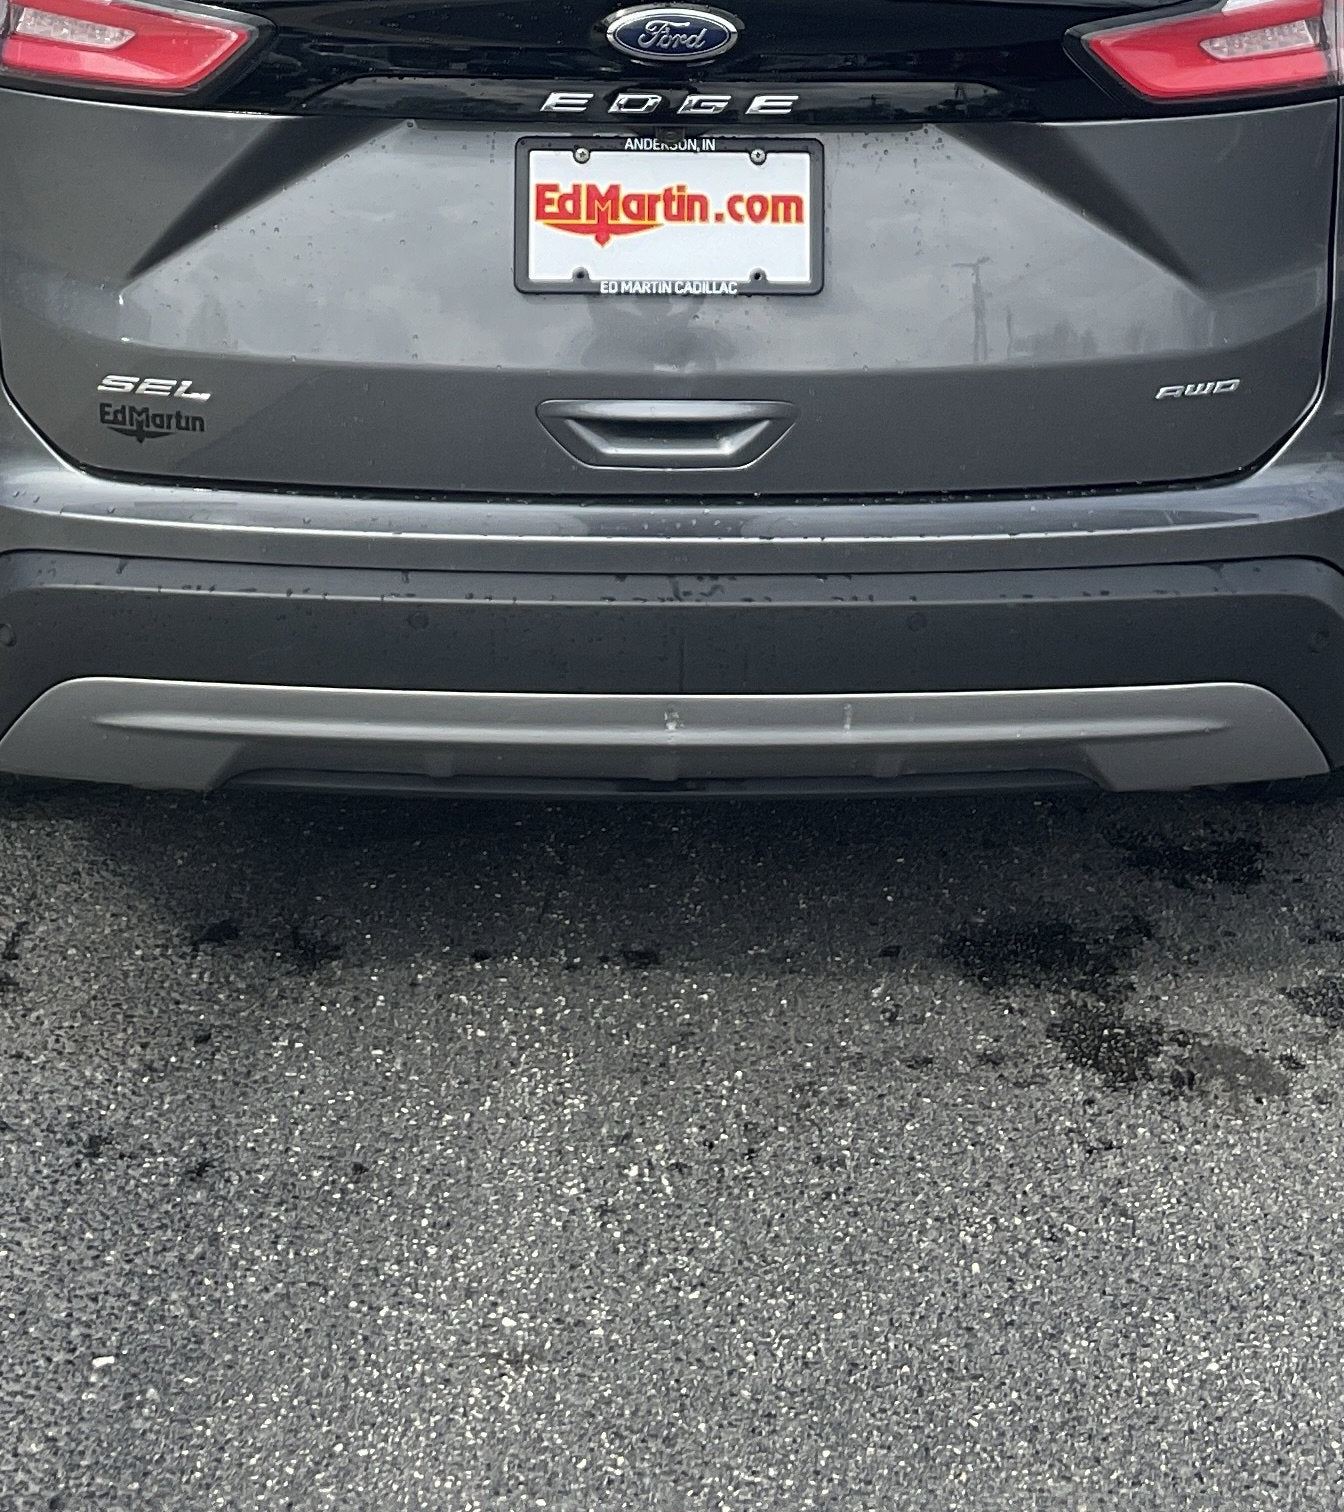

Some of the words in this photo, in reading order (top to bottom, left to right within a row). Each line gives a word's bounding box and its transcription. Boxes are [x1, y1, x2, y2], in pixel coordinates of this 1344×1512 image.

[637, 19, 707, 51] Ford
[539, 92, 800, 115] EDGE
[534, 183, 805, 230] EdMartin.com
[599, 281, 618, 295] ED
[620, 281, 672, 295] MARTIN
[674, 281, 738, 295] CADILLAC
[97, 374, 212, 402] SEL
[1154, 378, 1241, 399] AWD
[99, 401, 205, 433] EdMartin
